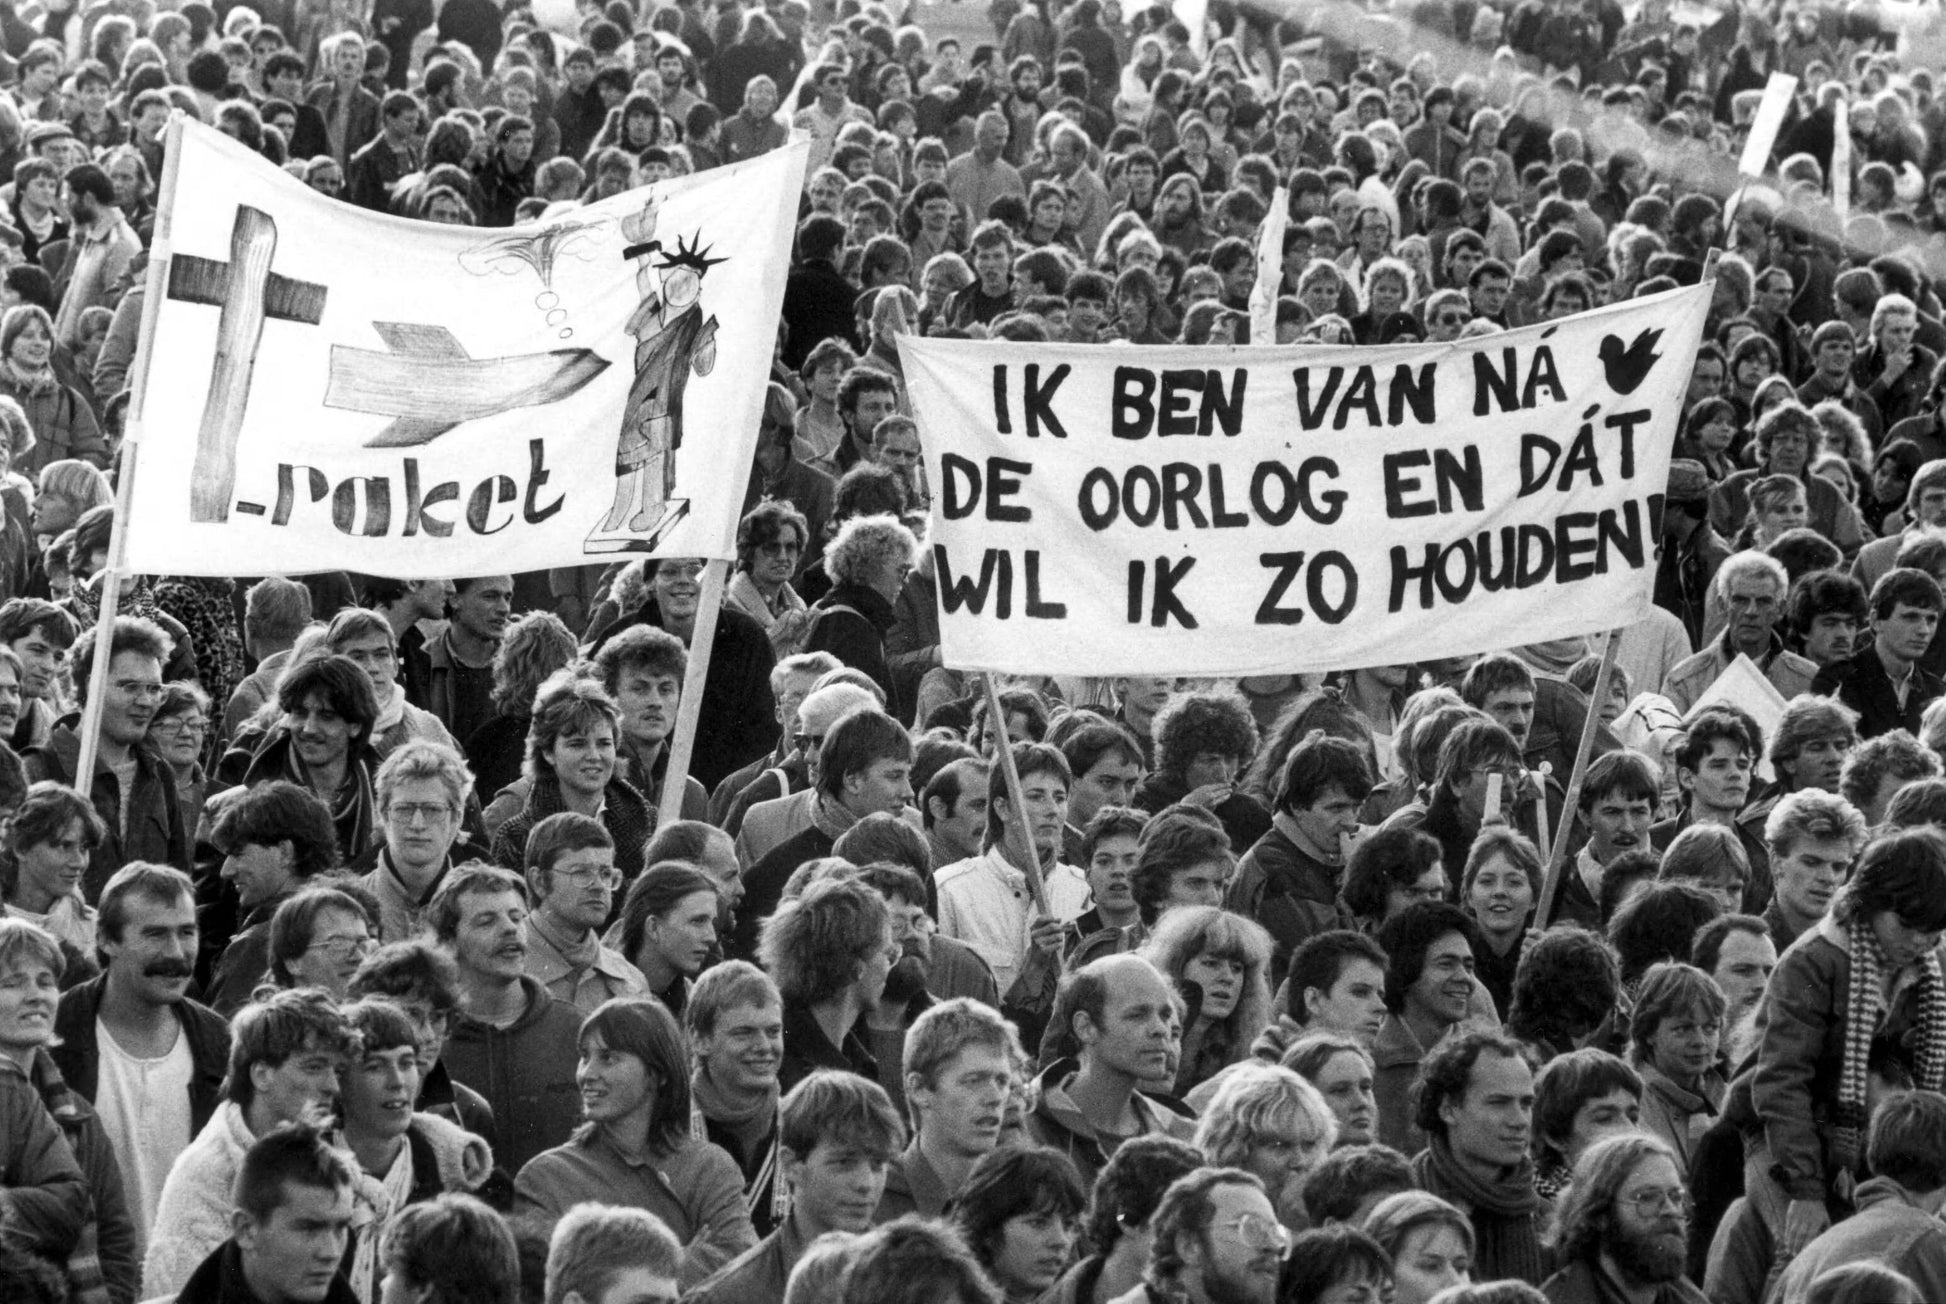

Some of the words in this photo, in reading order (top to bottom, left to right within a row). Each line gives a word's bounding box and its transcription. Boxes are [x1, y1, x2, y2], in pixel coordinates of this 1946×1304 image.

[993, 363, 1072, 439] IK
[1111, 365, 1248, 441] BEN
[1292, 361, 1438, 431] VAN
[1472, 325, 1568, 417] NÁ
[941, 452, 1033, 523] DE
[1077, 456, 1349, 532] OORLOG
[1382, 444, 1485, 519] EN
[1516, 403, 1652, 499] DÁT
[933, 543, 1067, 620] WIL
[1127, 555, 1199, 630] IK
[1254, 550, 1359, 626] ZO
[1388, 492, 1665, 613] HOUDEN!
